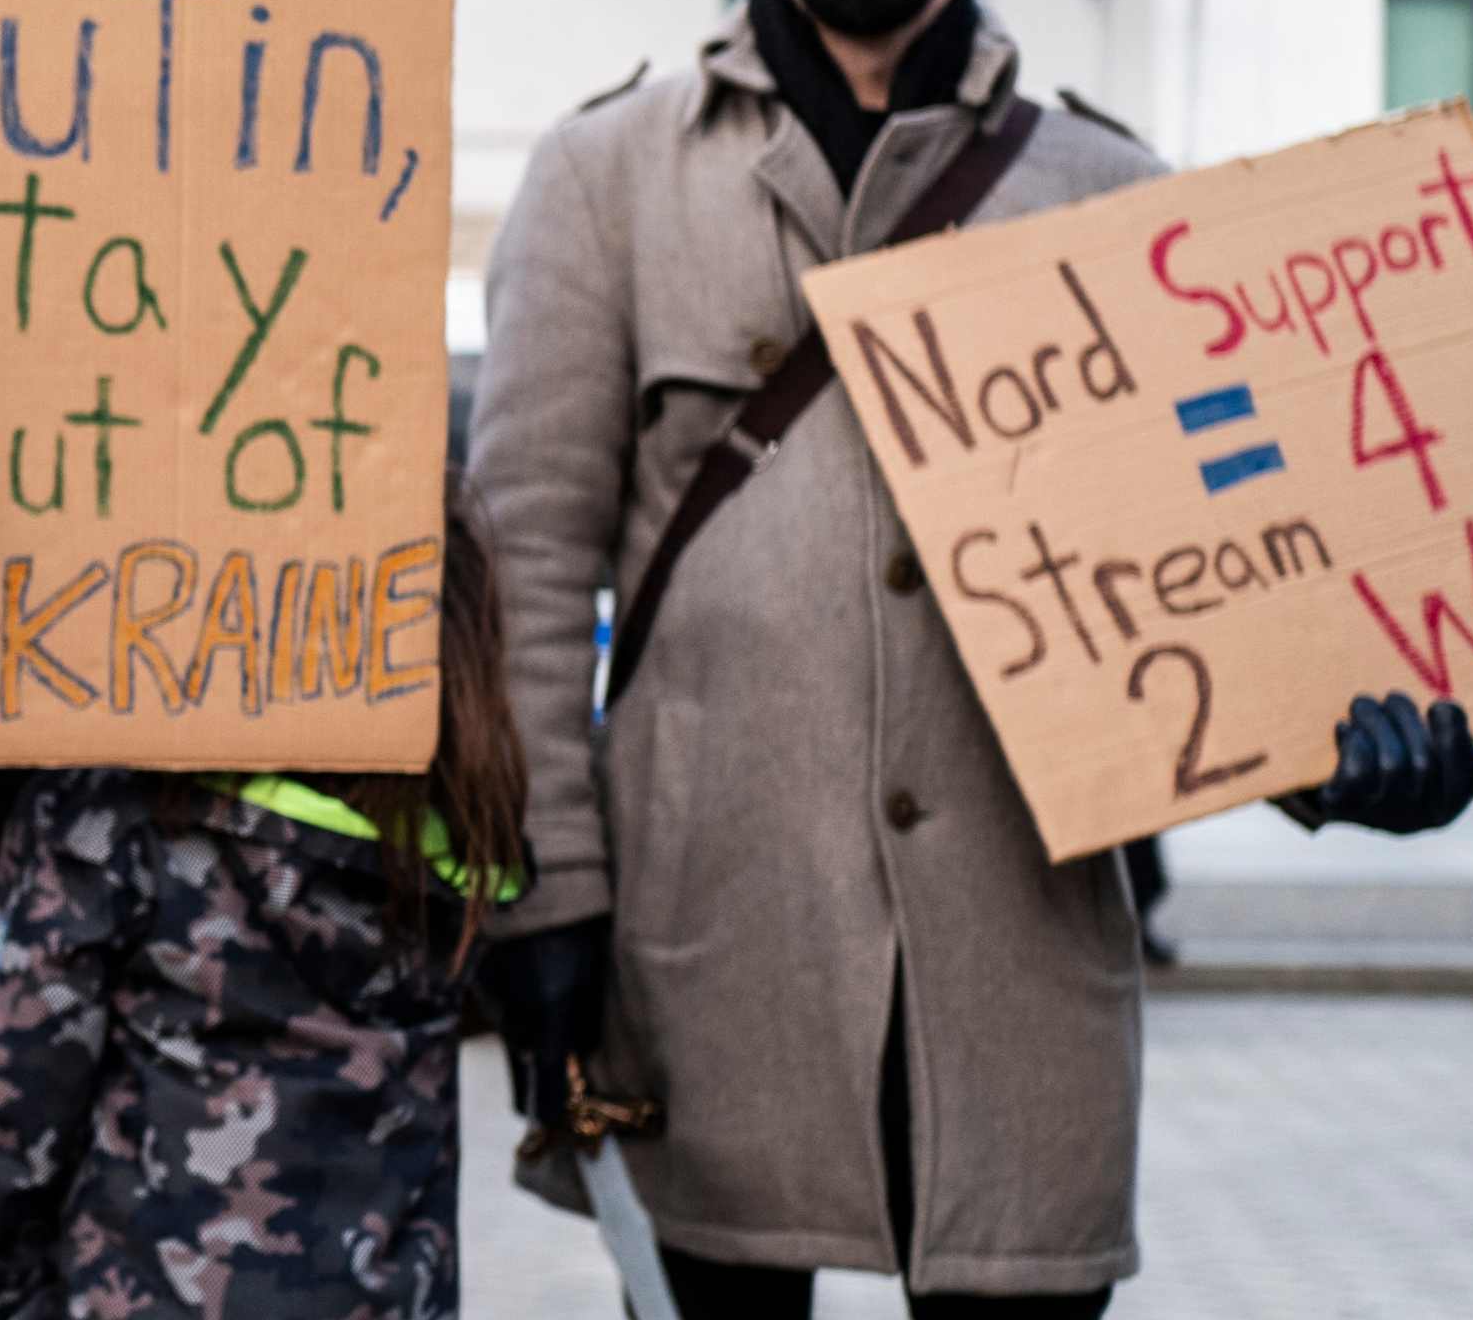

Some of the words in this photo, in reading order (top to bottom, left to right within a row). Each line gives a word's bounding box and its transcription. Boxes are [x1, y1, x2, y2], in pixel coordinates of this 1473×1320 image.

[225, 344, 380, 513] of
[851, 261, 1137, 467] Nord
[1173, 384, 1286, 495] =
[1350, 348, 1447, 511] 4
[951, 518, 1333, 678] Stream
[1126, 643, 1268, 800] 2
